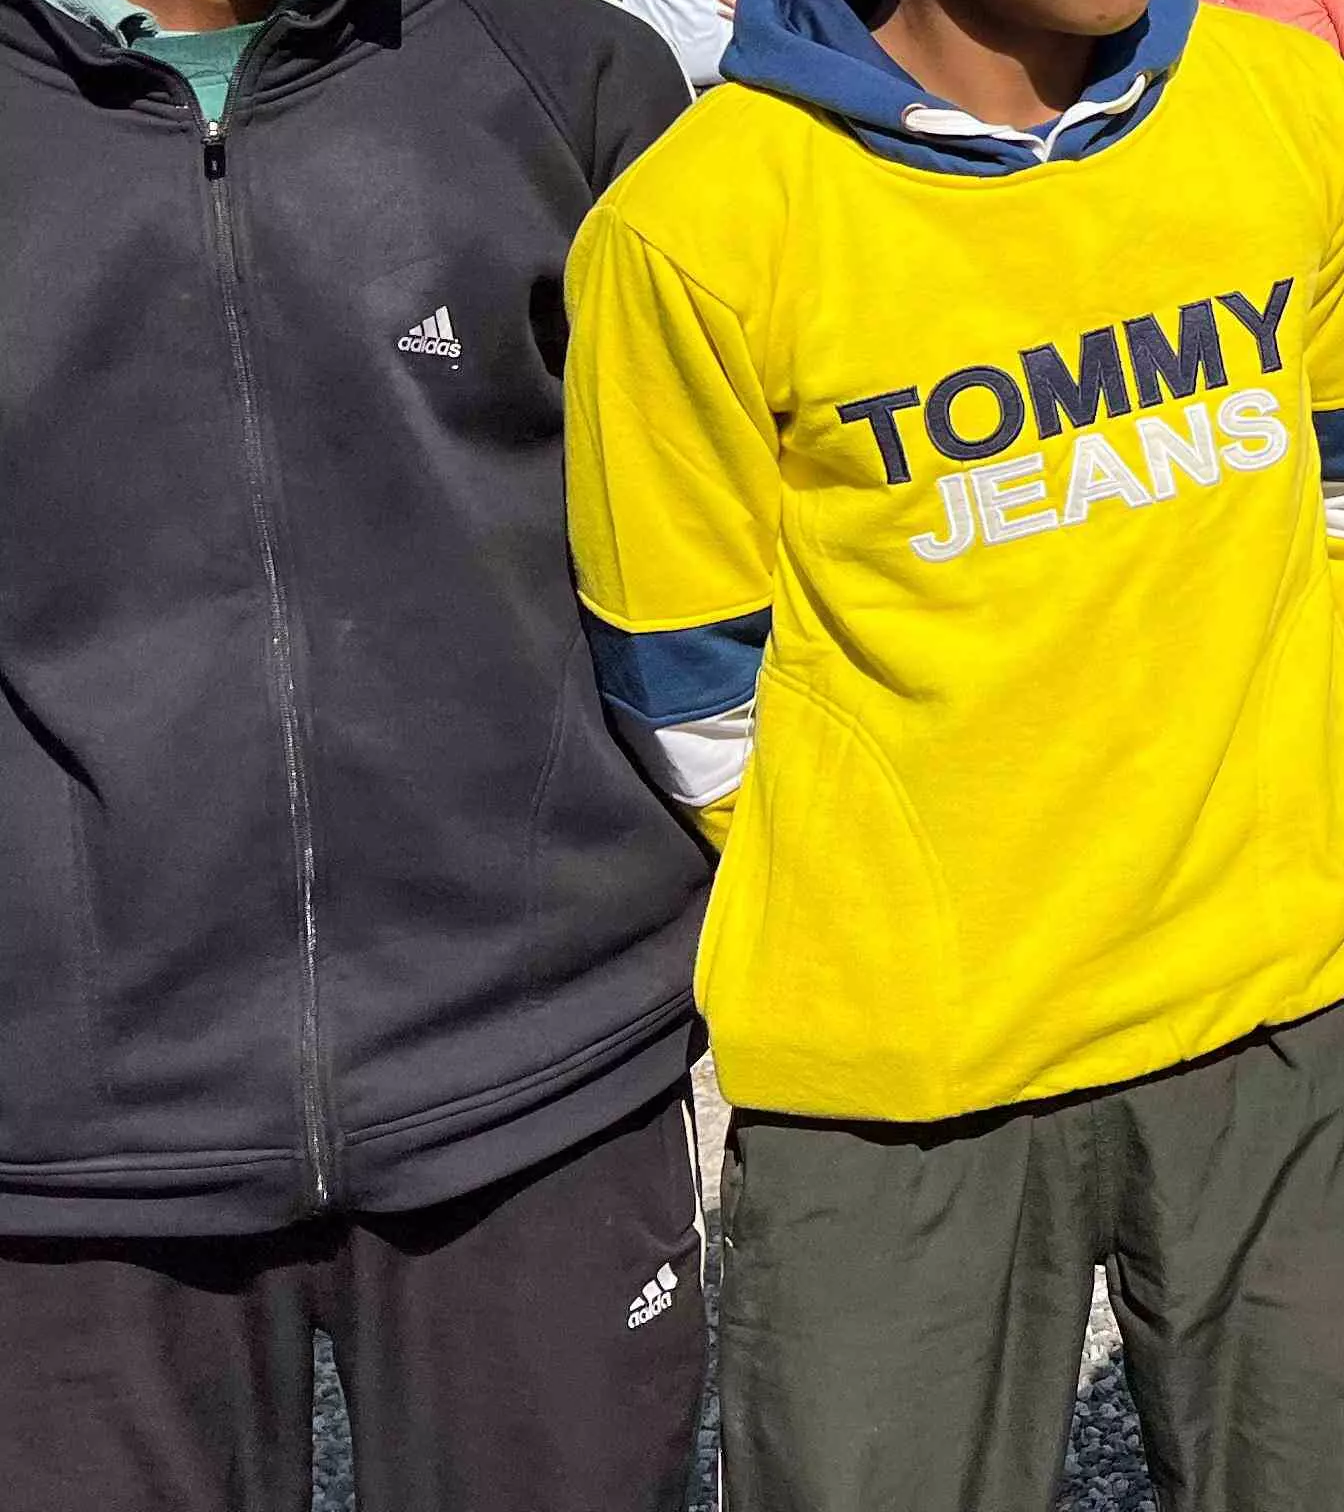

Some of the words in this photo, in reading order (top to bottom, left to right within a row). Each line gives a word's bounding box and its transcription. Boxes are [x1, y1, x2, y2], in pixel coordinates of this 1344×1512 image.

[398, 336, 461, 358] adidas
[836, 277, 1294, 484] TOMMY
[909, 388, 1288, 562] JEANS
